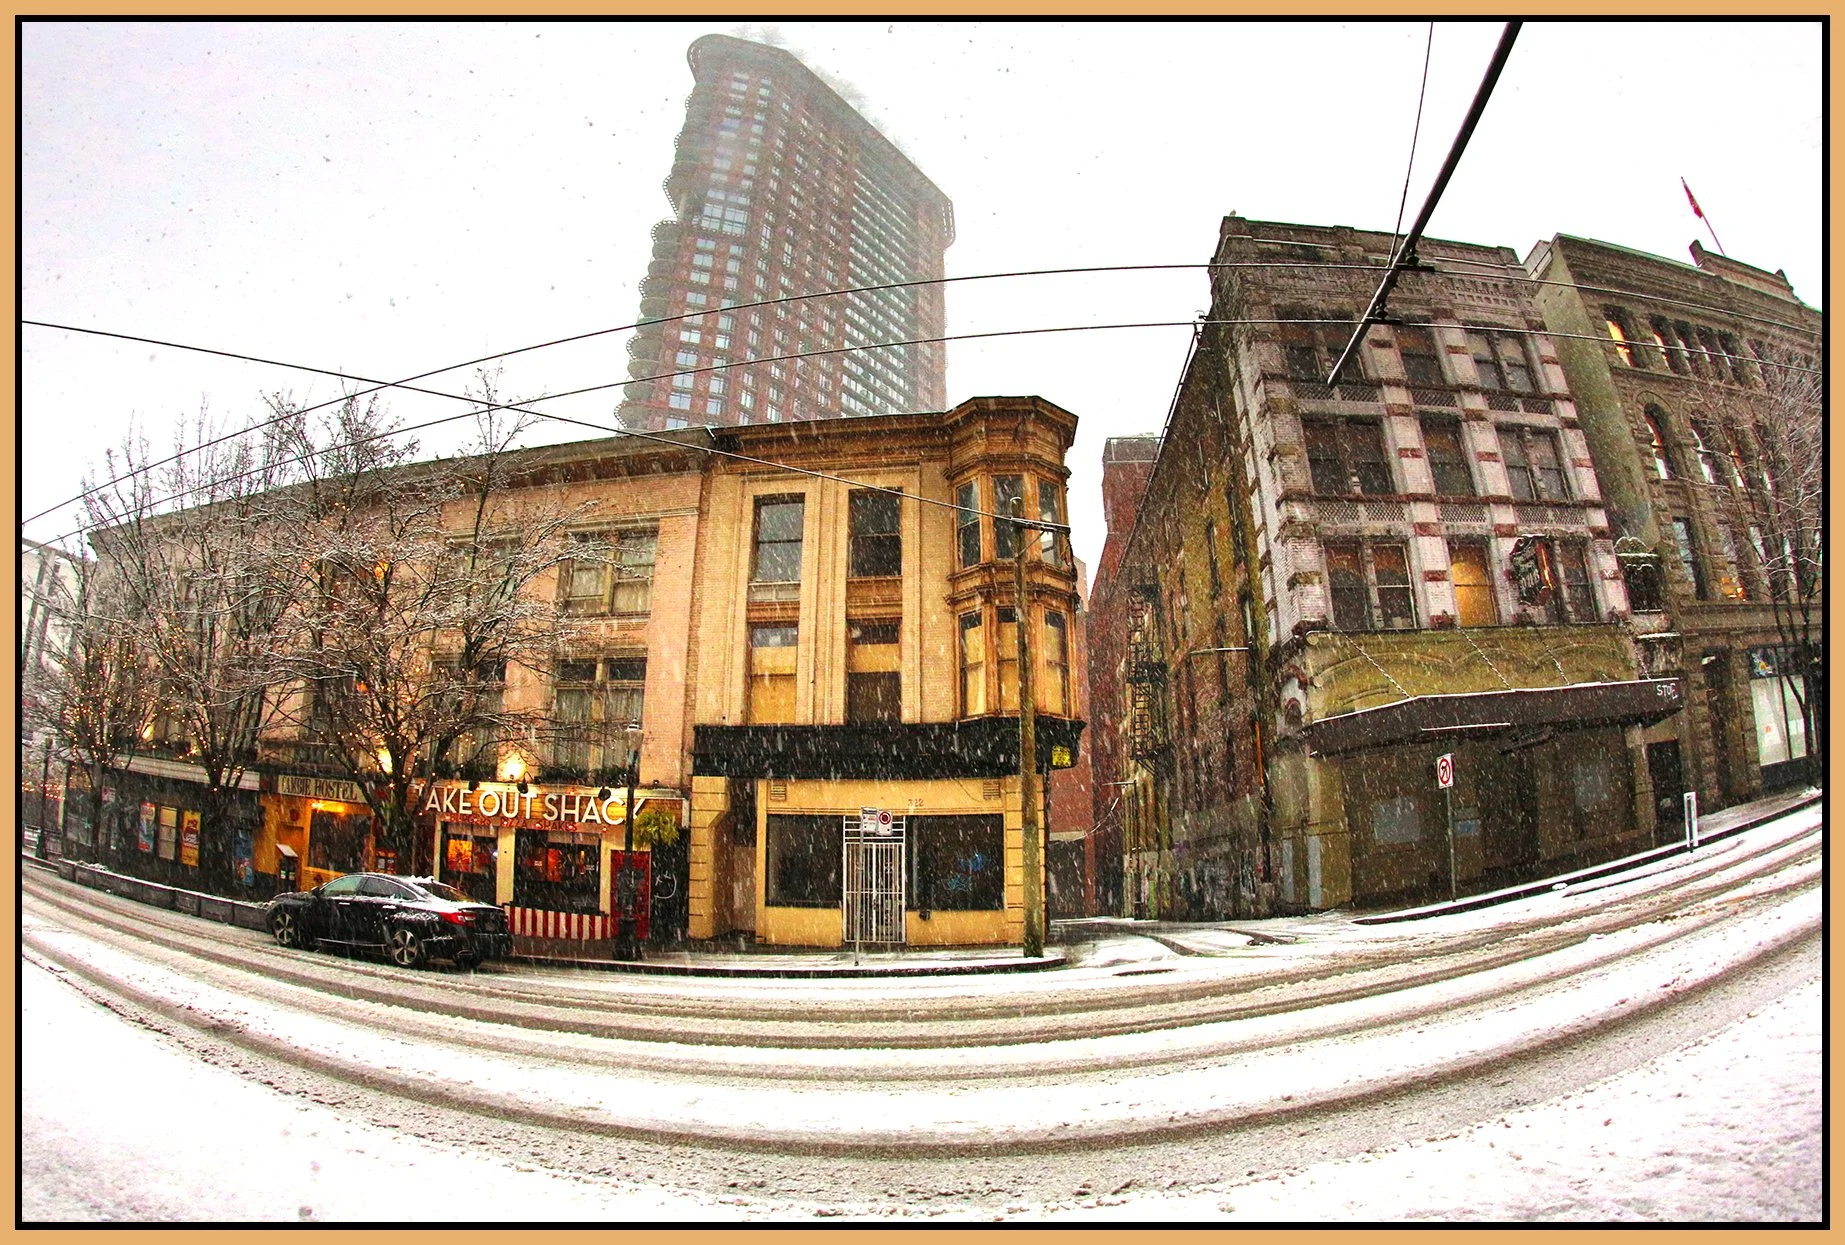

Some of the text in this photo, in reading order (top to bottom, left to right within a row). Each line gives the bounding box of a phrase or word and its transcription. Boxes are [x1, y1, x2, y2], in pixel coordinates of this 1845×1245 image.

[314, 779, 358, 800] HOSTEL
[479, 789, 538, 820] OUT
[537, 820, 578, 832] SHAKES
